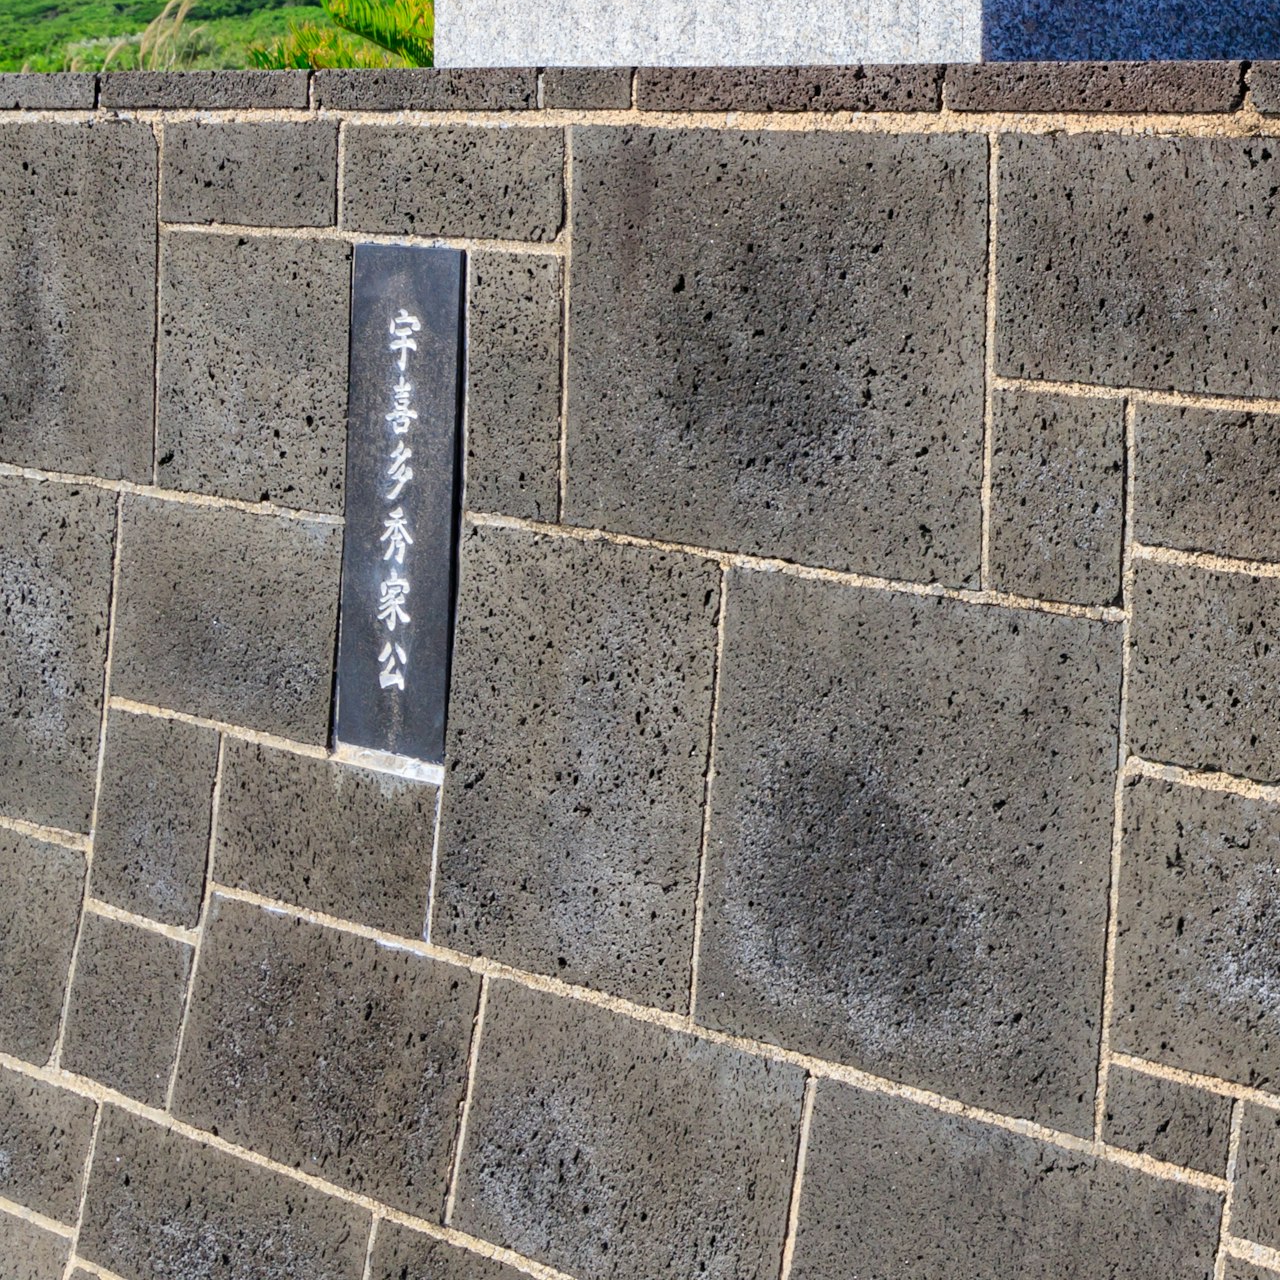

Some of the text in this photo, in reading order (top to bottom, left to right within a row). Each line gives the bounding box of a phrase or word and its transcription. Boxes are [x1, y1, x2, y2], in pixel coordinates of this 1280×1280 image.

[376, 308, 422, 691] 宇喜多秀家公
